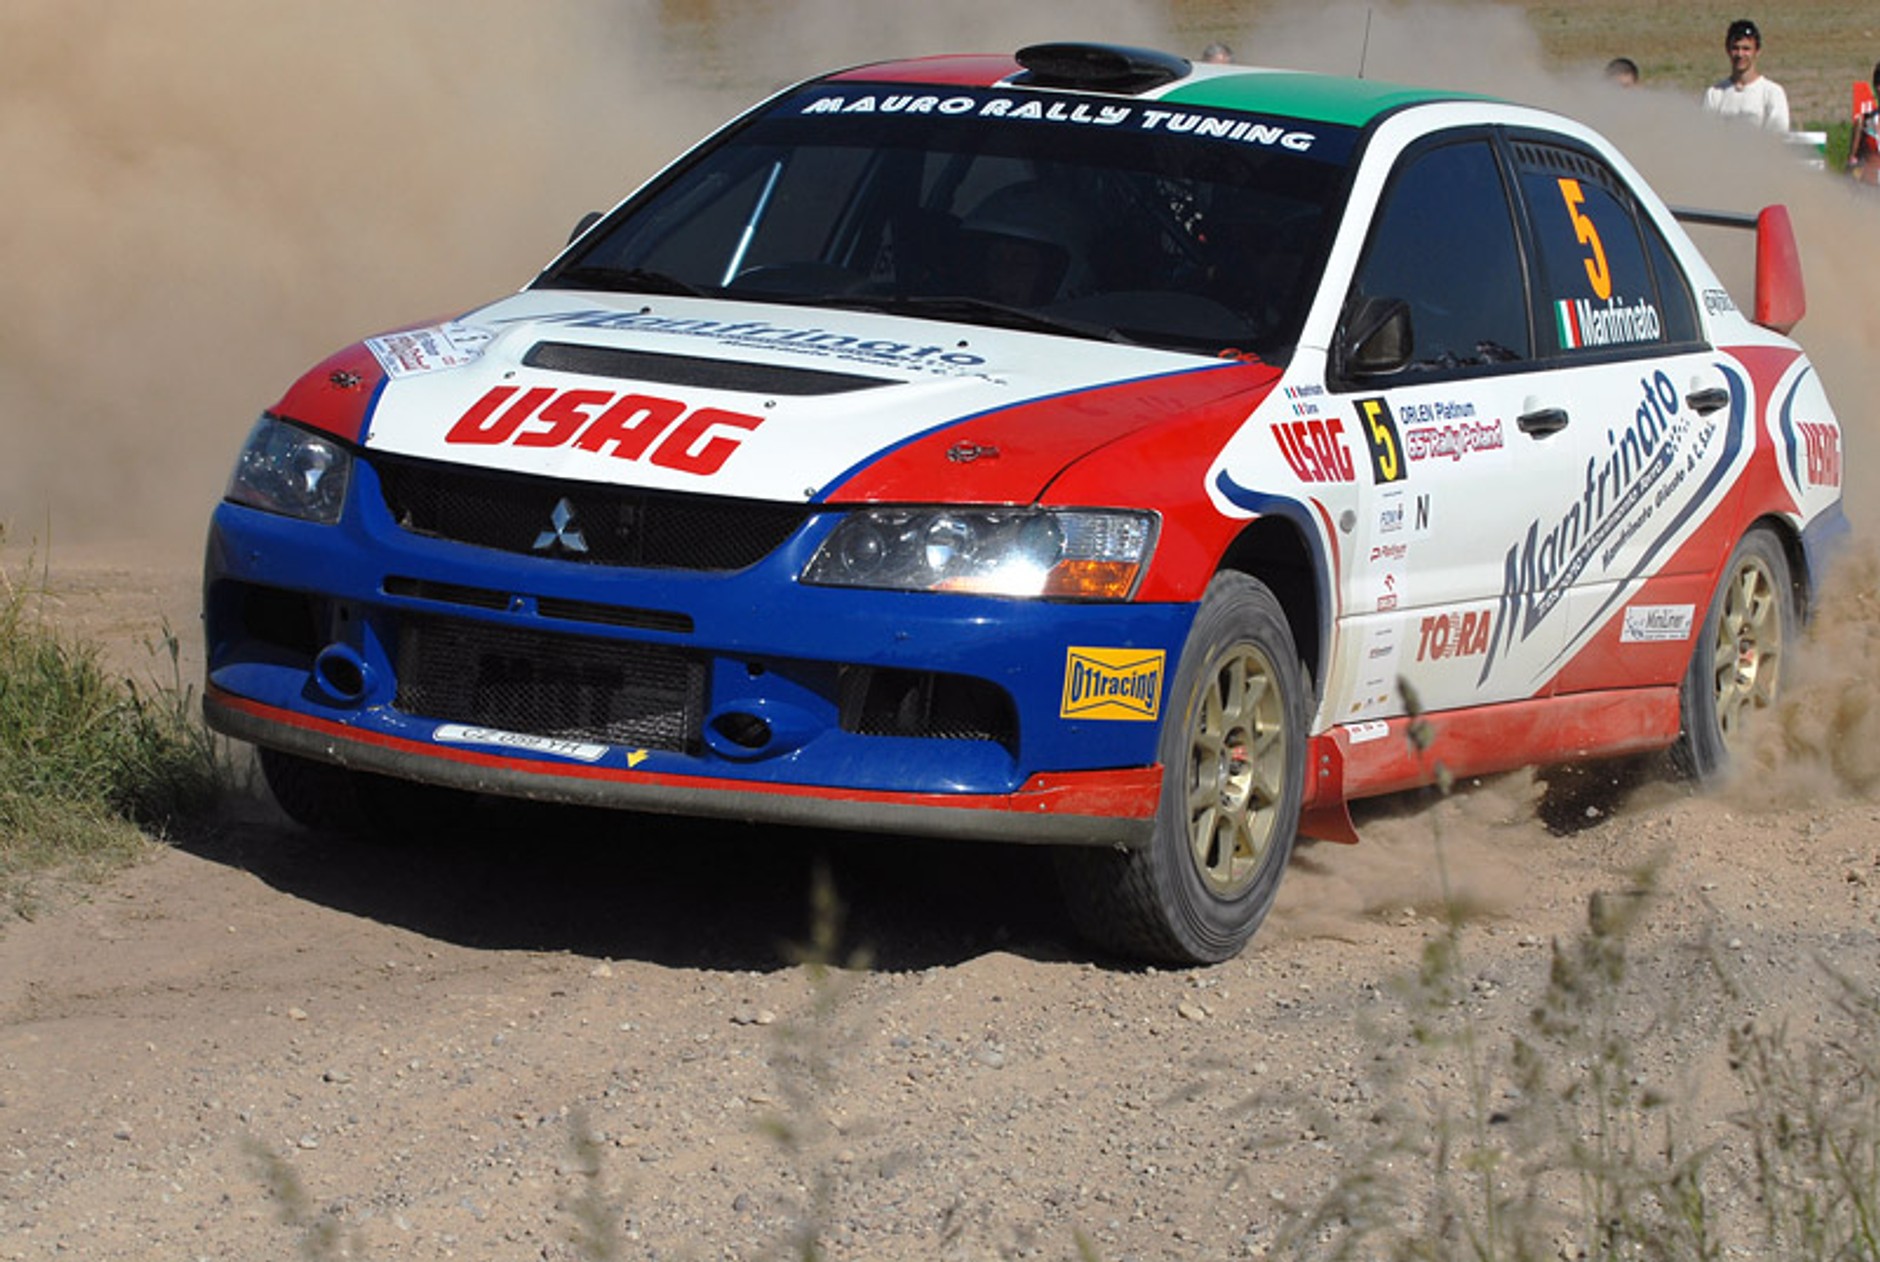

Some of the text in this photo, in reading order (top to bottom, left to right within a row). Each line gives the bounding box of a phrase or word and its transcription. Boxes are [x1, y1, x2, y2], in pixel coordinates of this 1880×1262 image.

[801, 95, 1316, 151] MAURO RALLY TUNING
[1557, 178, 1612, 300] 5
[490, 309, 985, 366] Manfrinato
[1576, 297, 1661, 347] Manfrinato
[444, 385, 766, 476] USAG
[1363, 401, 1397, 481] 5
[1400, 404, 1434, 424] ORLEN
[1271, 417, 1355, 483] USAG
[1795, 421, 1841, 488] USAG
[1415, 493, 1430, 531] N
[1477, 369, 1679, 690] Manfrinato
